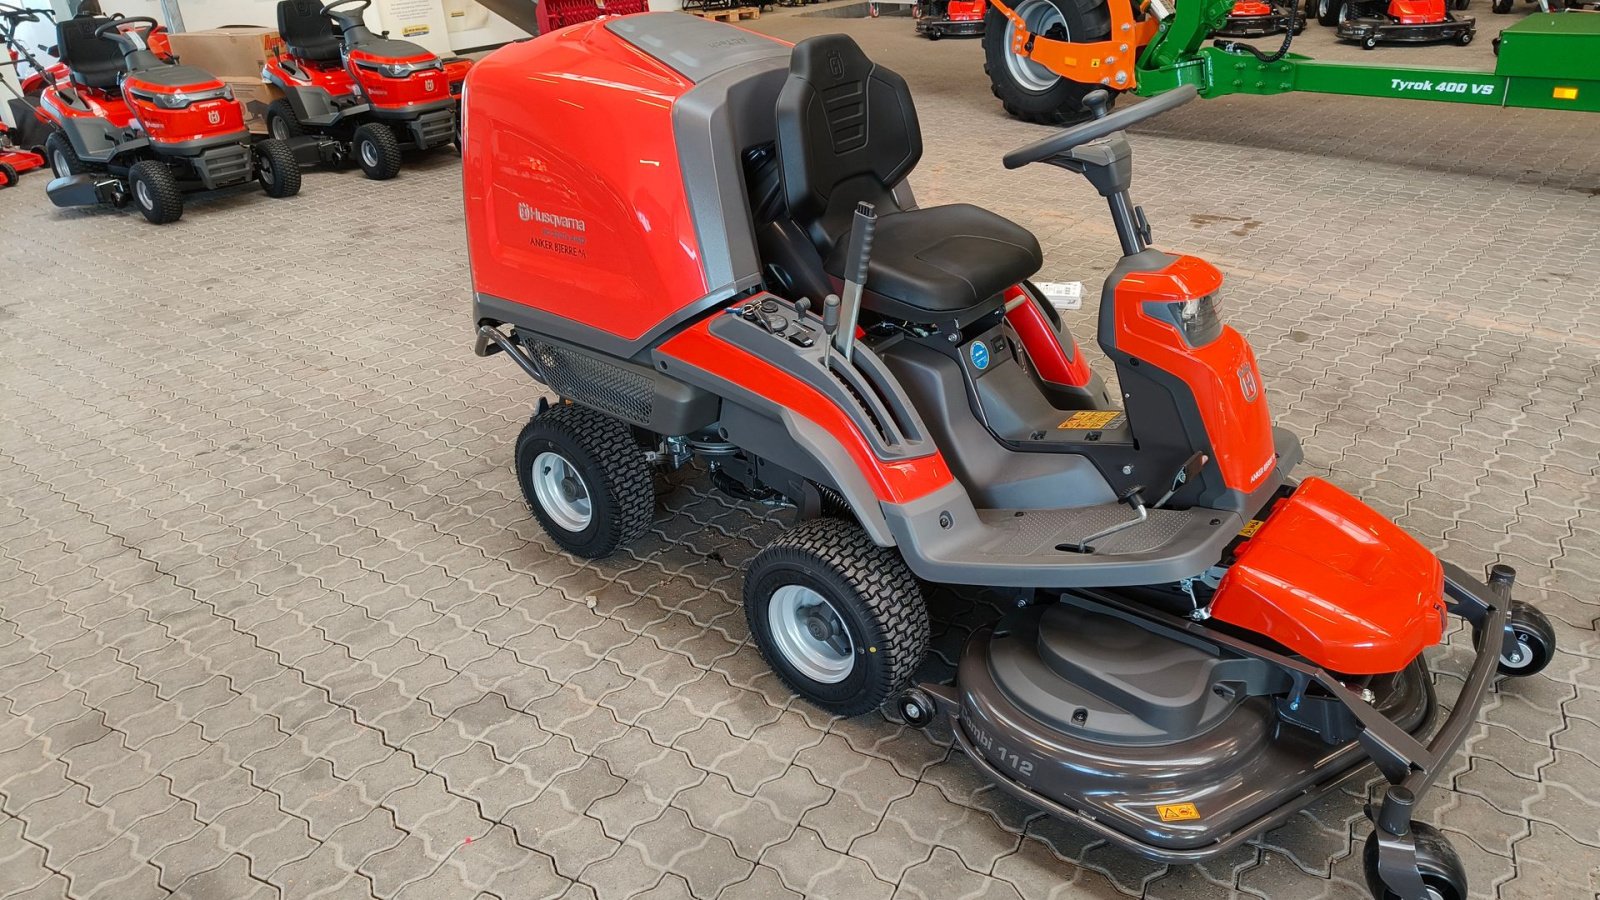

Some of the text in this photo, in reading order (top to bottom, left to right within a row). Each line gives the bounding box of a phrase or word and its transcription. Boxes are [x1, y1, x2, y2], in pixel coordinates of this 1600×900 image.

[1391, 79, 1495, 95] Tyrok 400 VS
[530, 206, 586, 232] Husqvarna
[530, 238, 554, 251] ANKER
[554, 242, 578, 257] BJERRE
[998, 747, 1033, 777] 112
